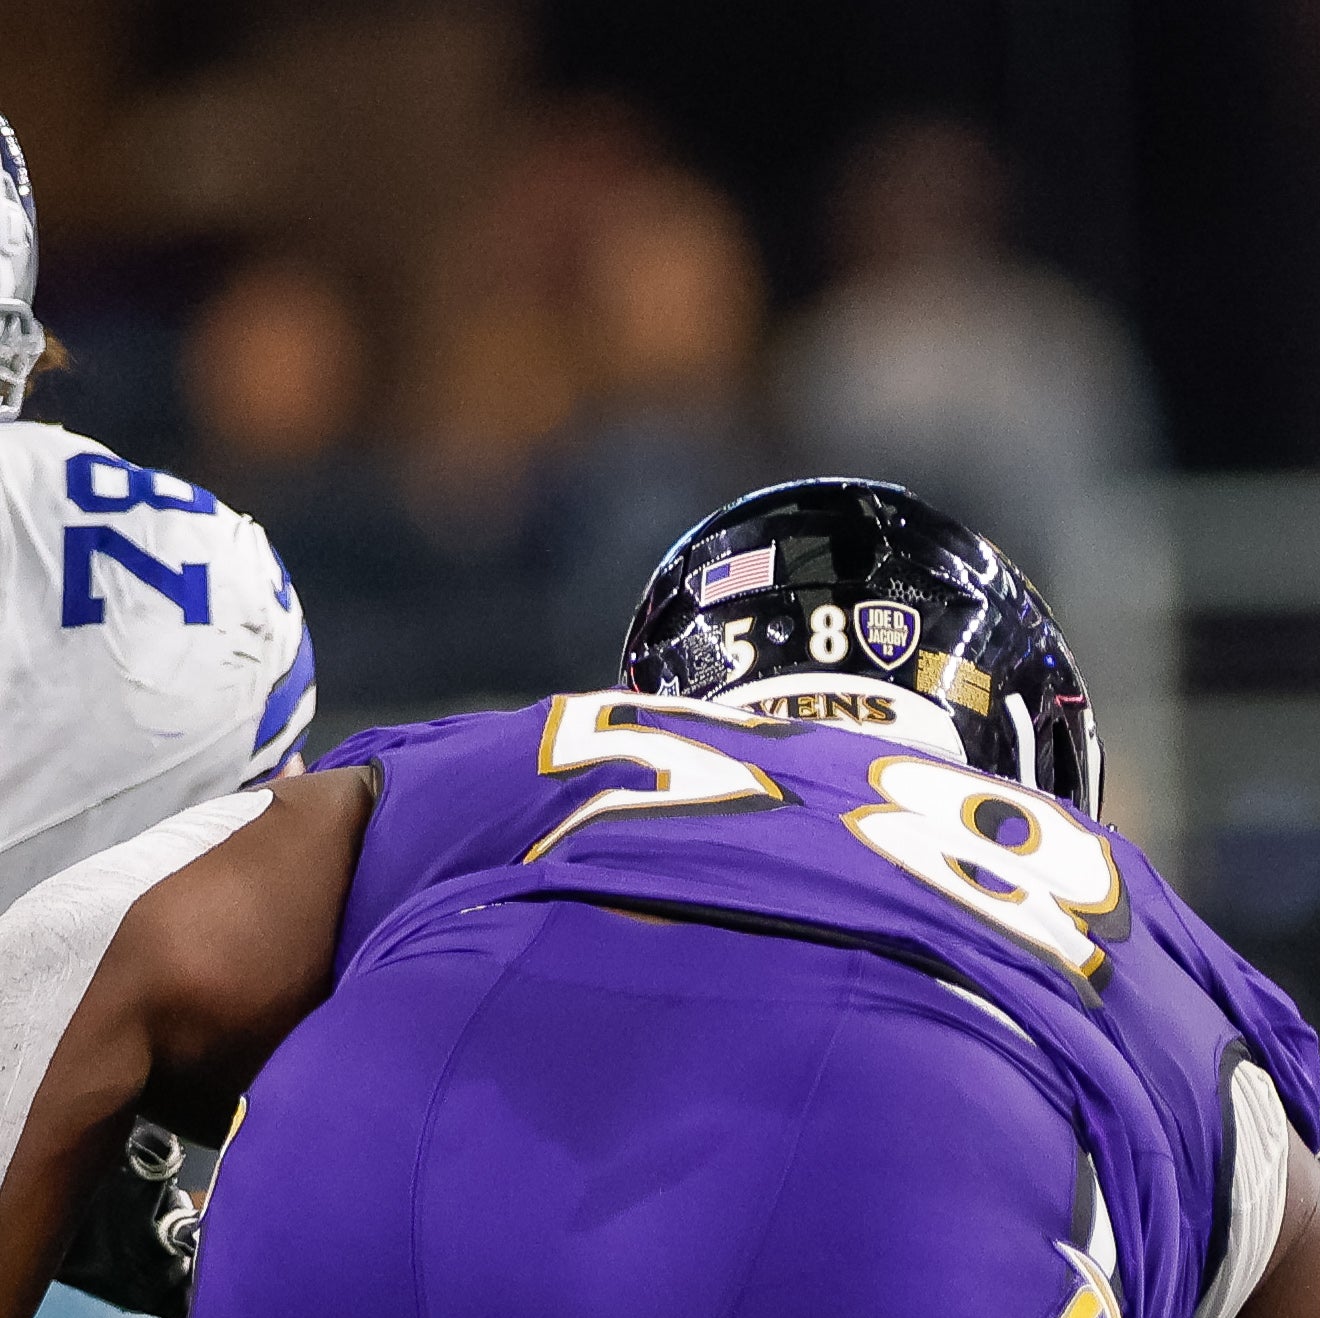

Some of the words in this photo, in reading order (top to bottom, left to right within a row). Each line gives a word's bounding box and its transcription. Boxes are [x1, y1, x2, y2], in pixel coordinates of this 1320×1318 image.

[61, 450, 217, 629] 78
[867, 608, 892, 628] JOE
[868, 628, 909, 648] JACOBY
[523, 690, 1128, 985] 58
